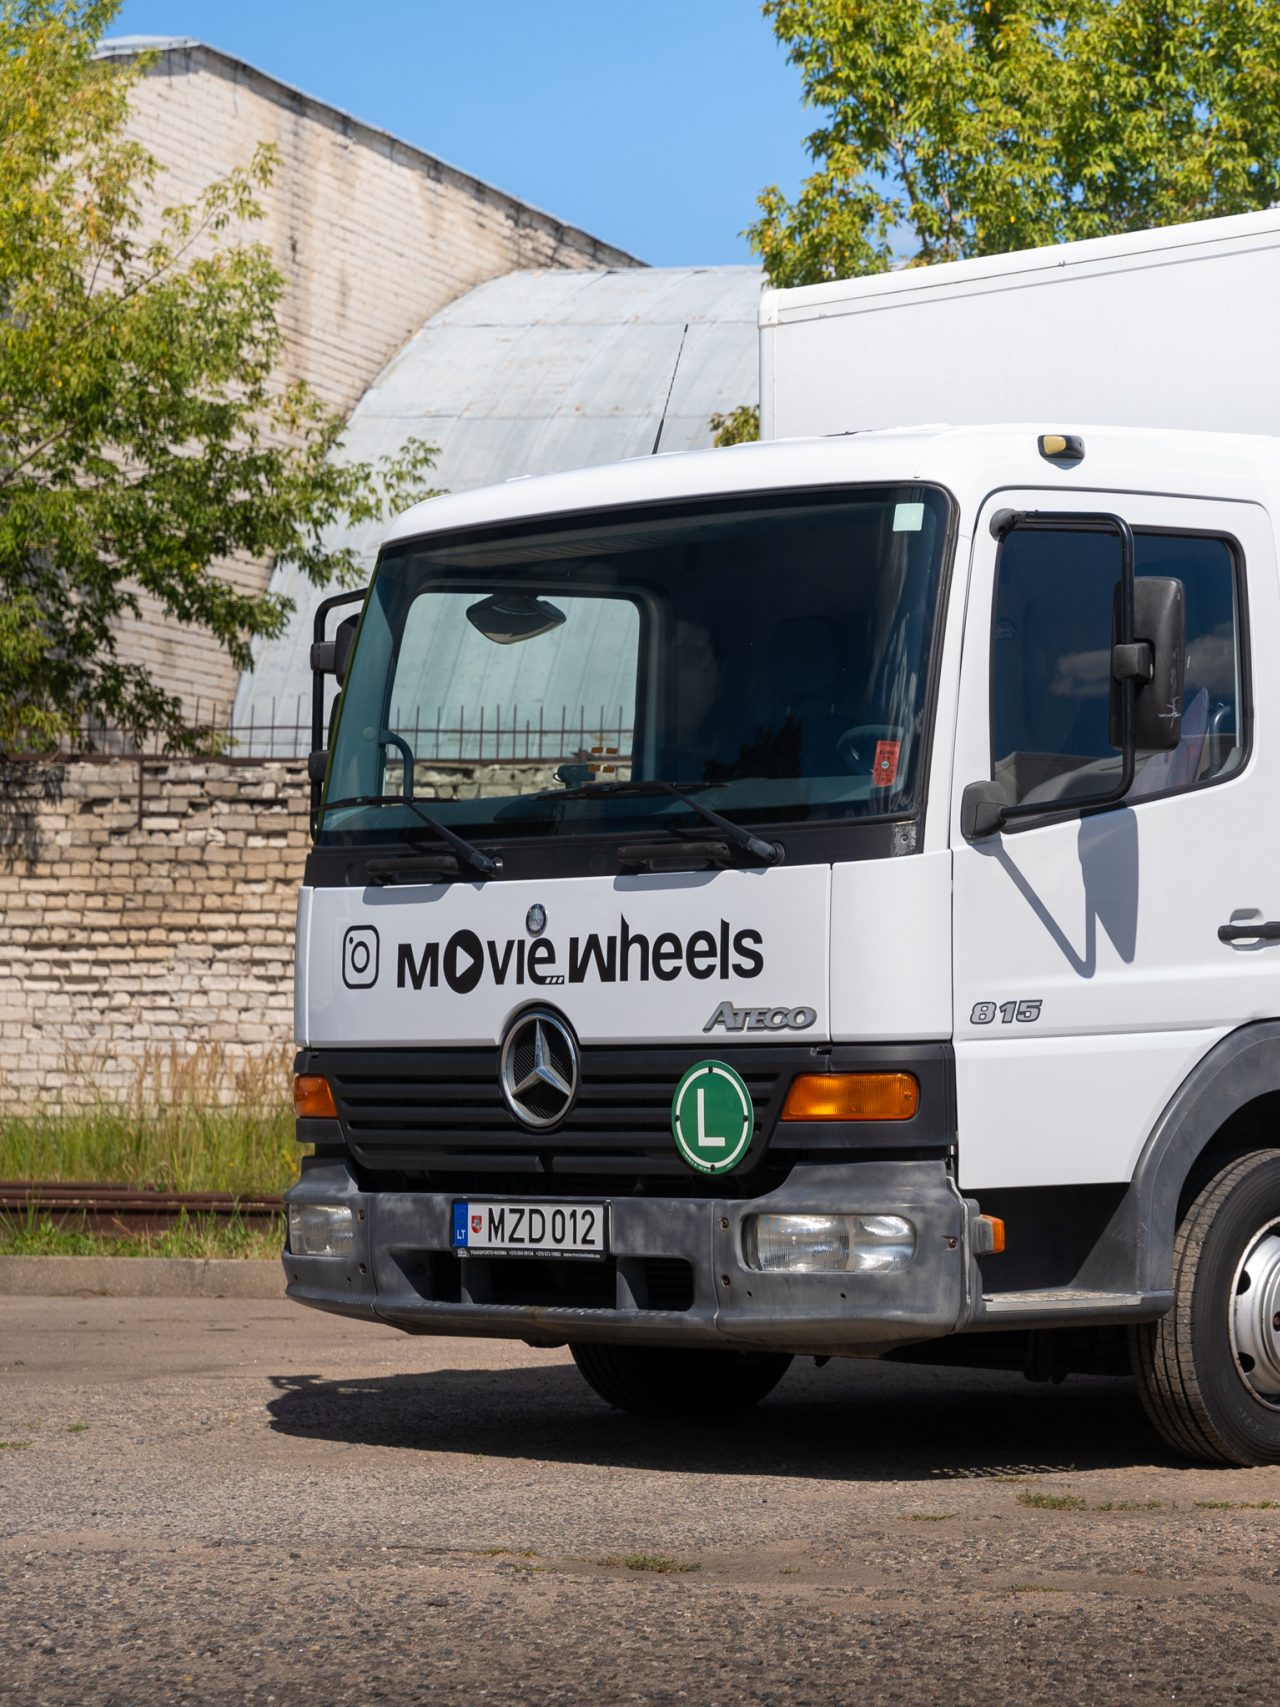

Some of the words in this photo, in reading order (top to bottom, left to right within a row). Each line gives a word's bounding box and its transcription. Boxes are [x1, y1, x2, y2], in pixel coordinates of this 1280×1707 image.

[969, 999, 1043, 1025] 815
[697, 1088, 726, 1147] L
[456, 1229, 467, 1240] LT
